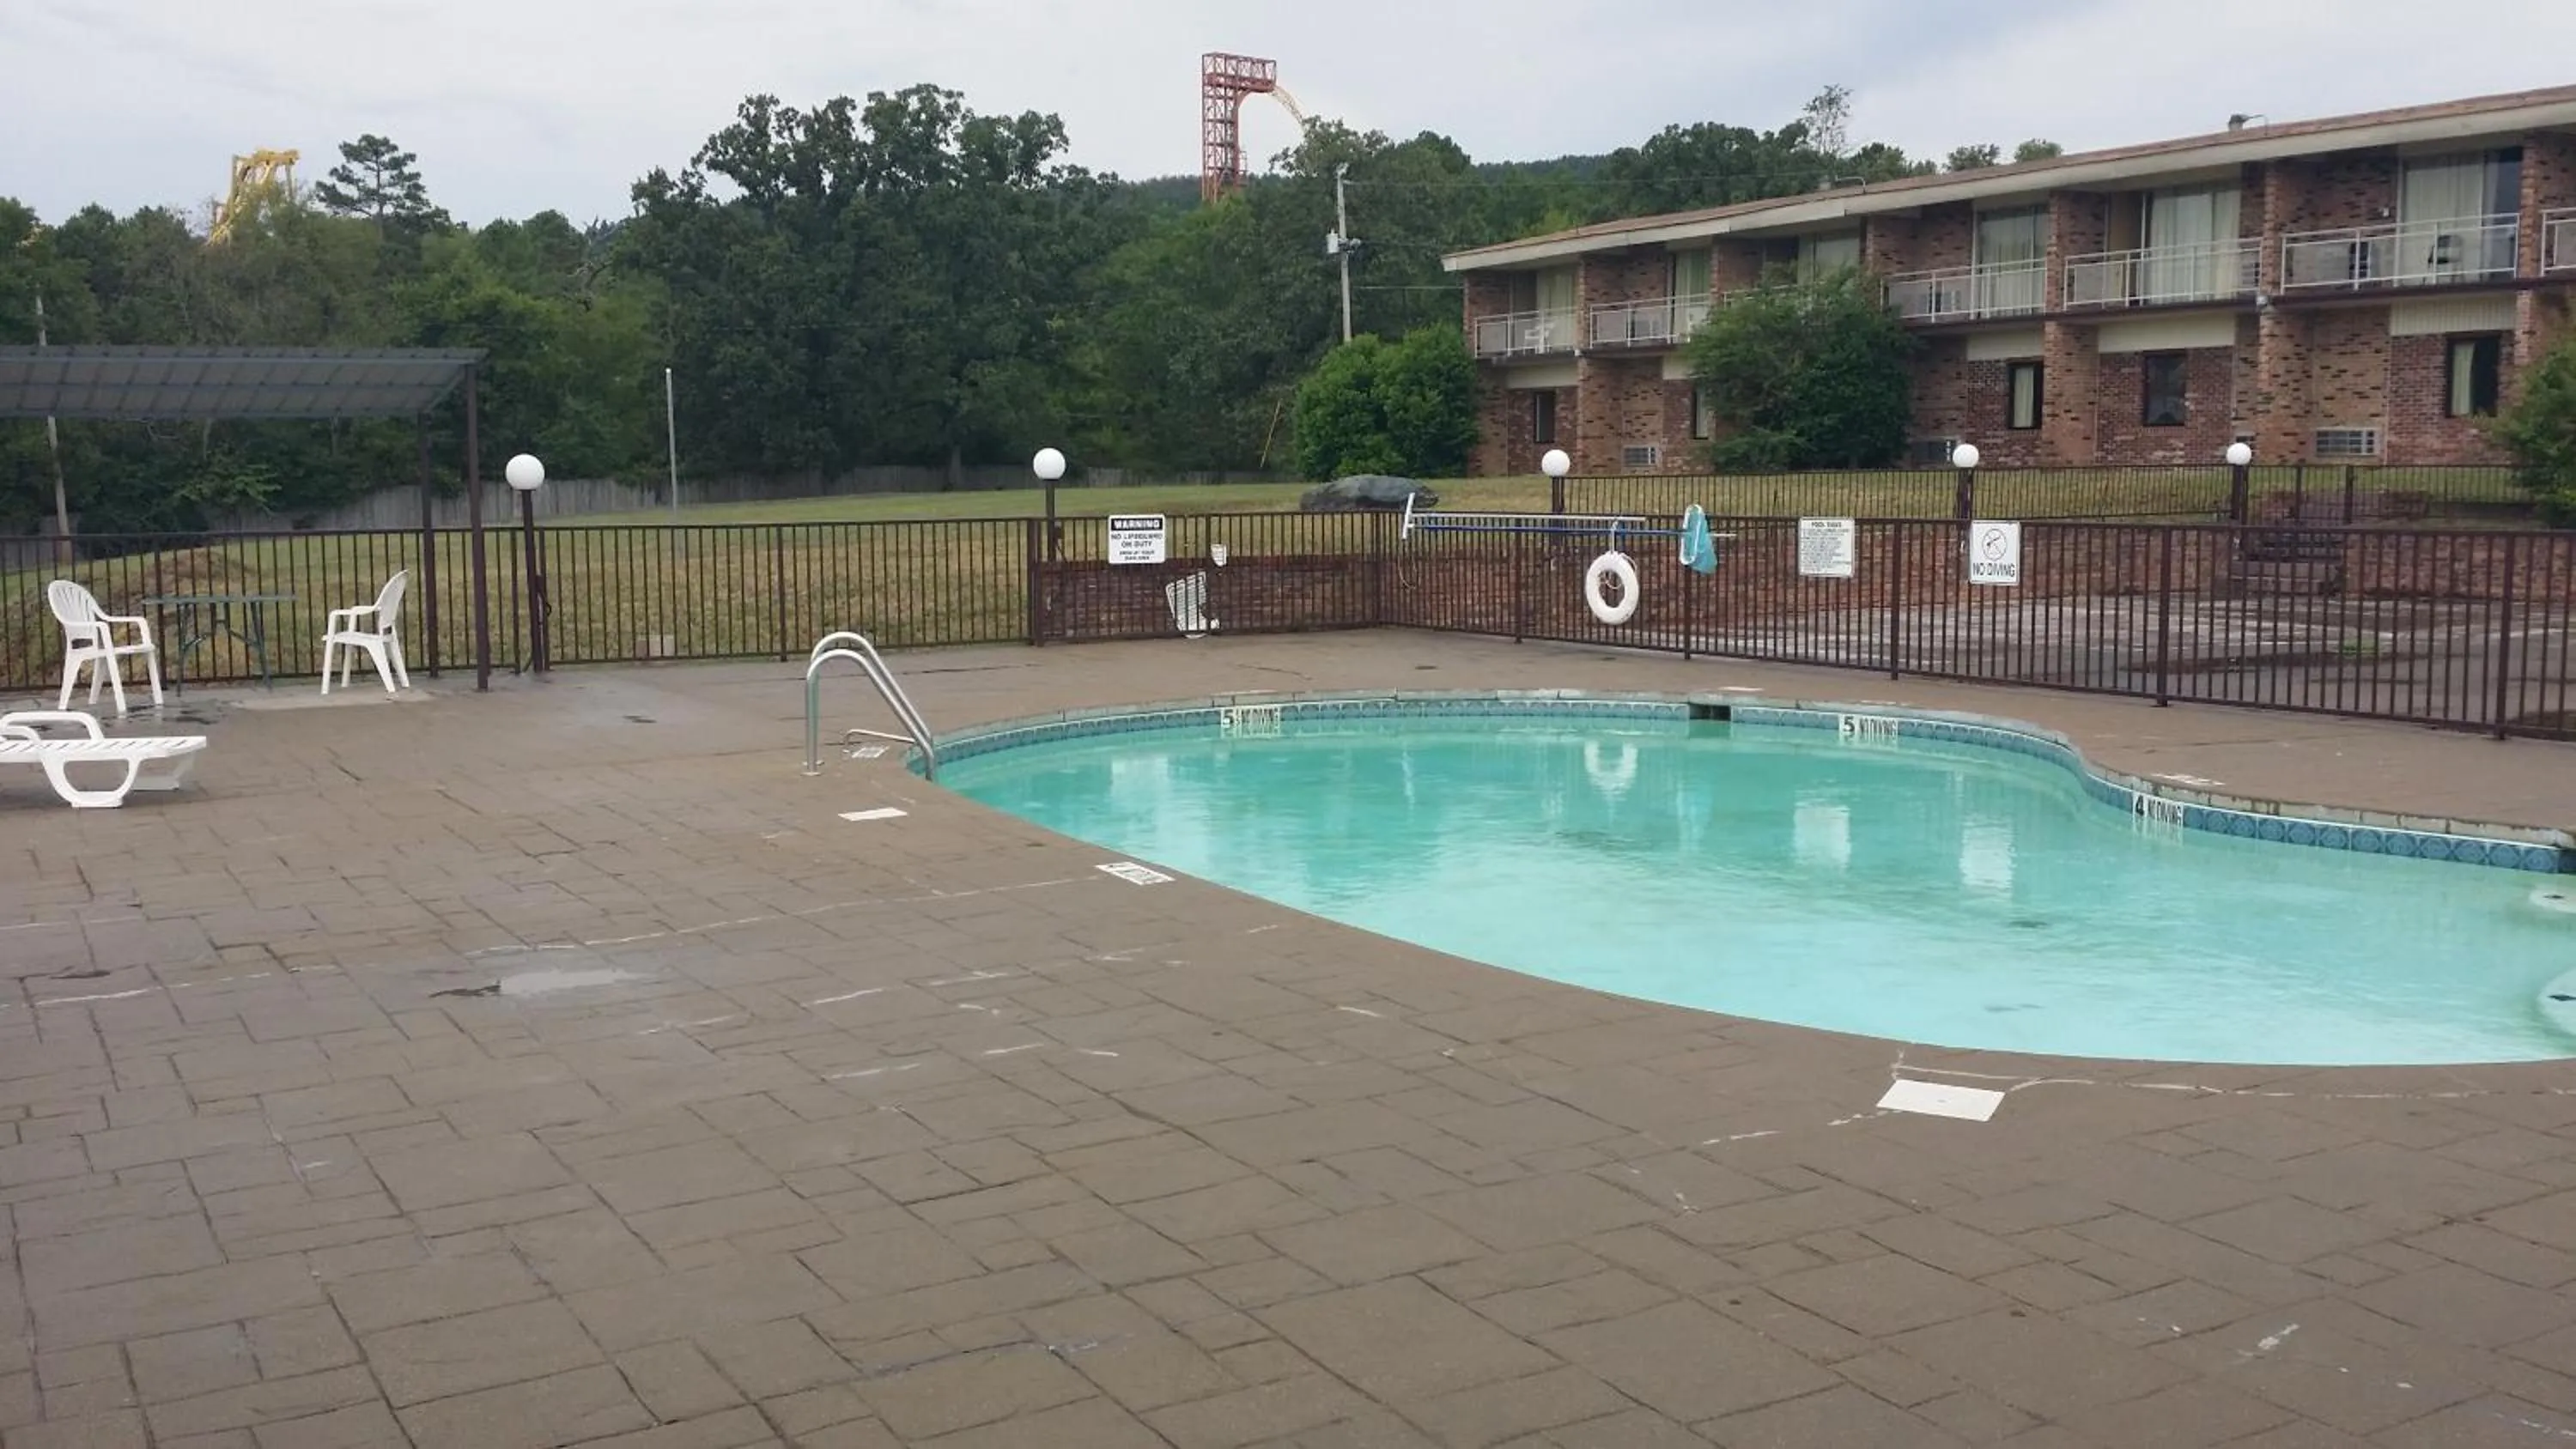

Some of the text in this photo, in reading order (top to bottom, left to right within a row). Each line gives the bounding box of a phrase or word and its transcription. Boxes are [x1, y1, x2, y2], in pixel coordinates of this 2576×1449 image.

[1114, 519, 1160, 530] WARNING
[1973, 562, 2015, 578] NO DIVING
[1223, 708, 1234, 724] 5
[1843, 715, 1856, 732] 5
[2136, 794, 2144, 816] 4
